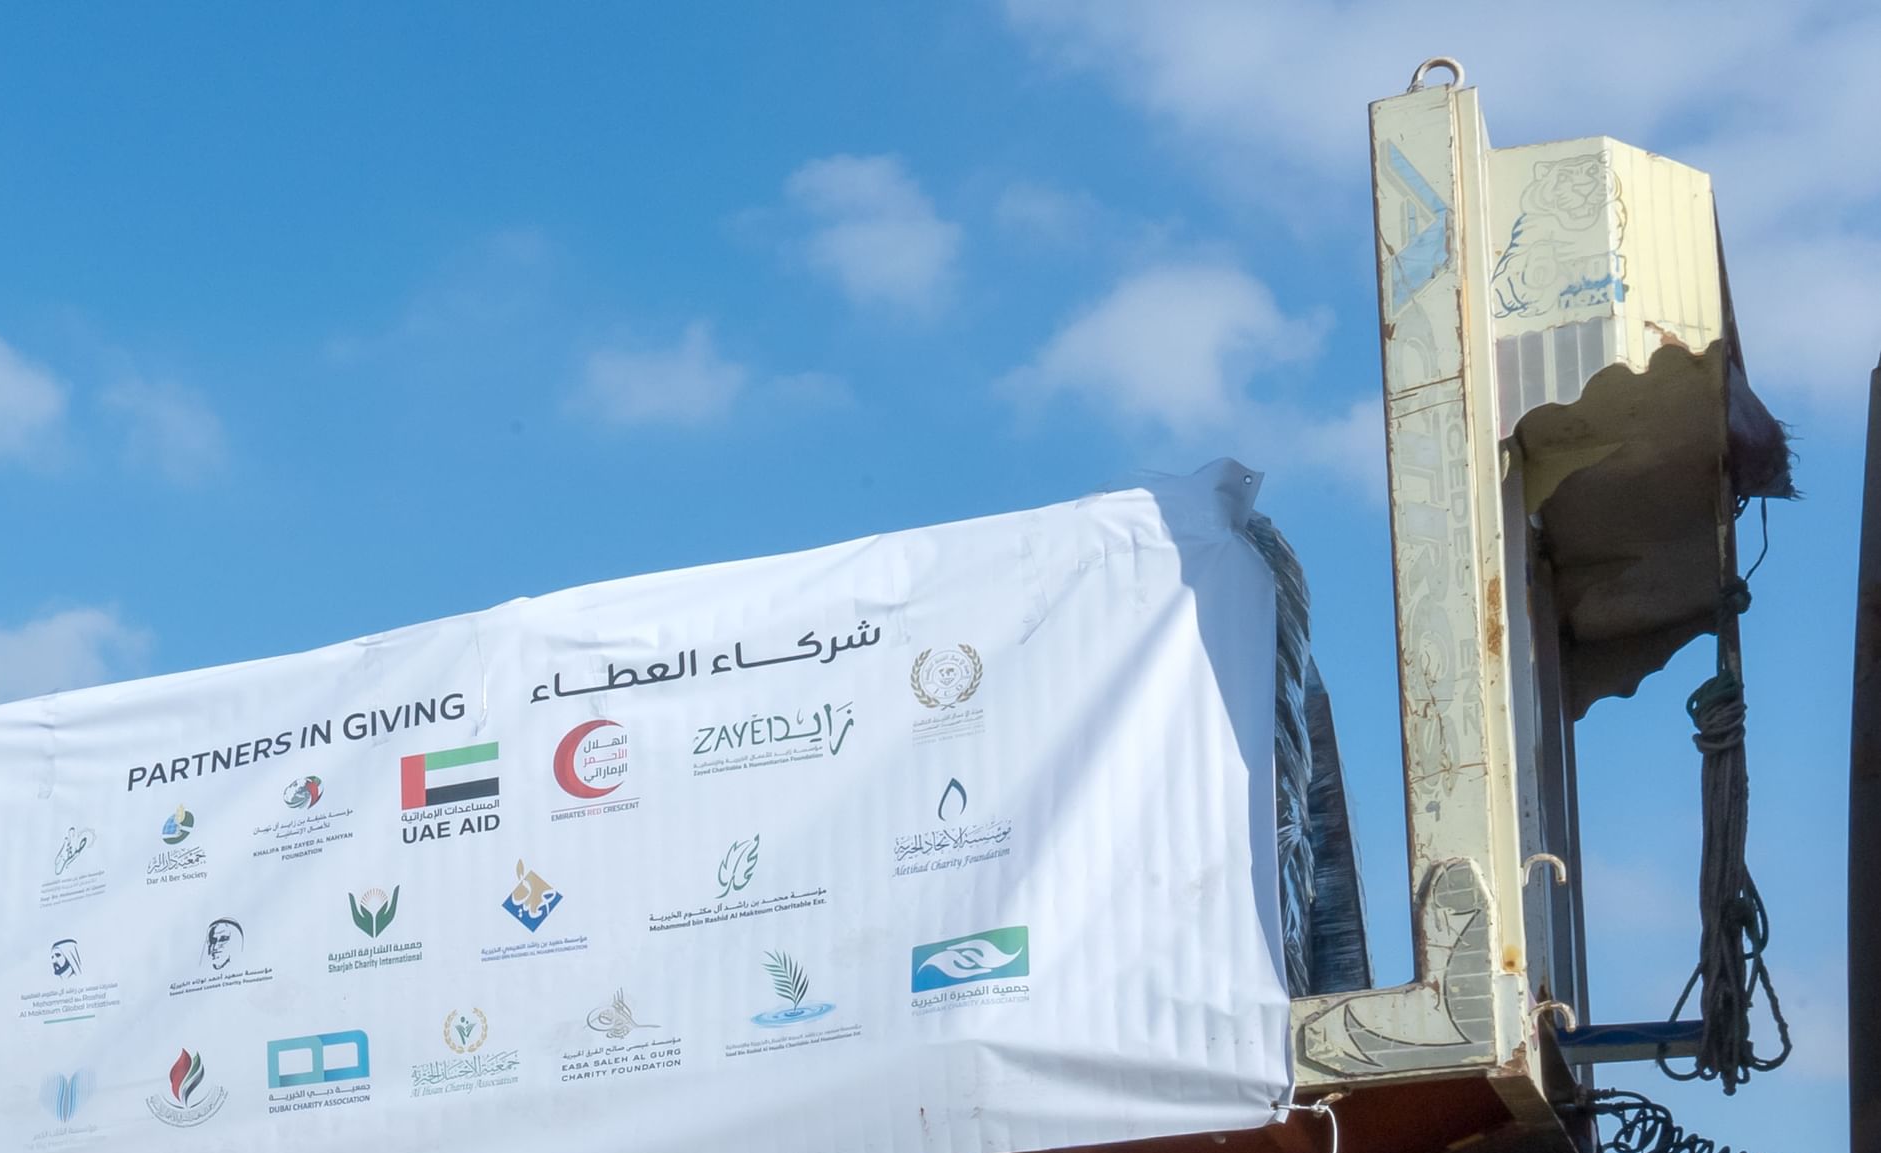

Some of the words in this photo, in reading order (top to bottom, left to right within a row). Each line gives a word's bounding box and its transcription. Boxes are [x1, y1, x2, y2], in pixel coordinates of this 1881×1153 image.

[711, 619, 881, 676] شركاء
[530, 649, 697, 704] العطاء
[127, 731, 291, 792] PARTNERS
[300, 719, 333, 750] IN
[343, 693, 466, 742] GIVING
[583, 734, 627, 754] الهلال
[401, 807, 443, 824] الإماراتية
[444, 799, 500, 816] المساعدات
[551, 809, 586, 822] EMIRATES
[587, 806, 601, 817] RED
[603, 801, 639, 814] CRESCENT
[402, 821, 451, 844] UAE
[459, 814, 500, 836] AID
[253, 847, 280, 857] KHALIFA
[281, 844, 293, 852] BIN
[294, 839, 315, 849] ZAYED
[316, 837, 324, 845] AL
[281, 847, 323, 861] FOUNDATION
[146, 876, 159, 885] Dar
[160, 875, 168, 884] Al
[169, 874, 181, 883] Ber
[182, 871, 208, 882] Society
[649, 919, 691, 932] Mohammed
[692, 917, 703, 926] bin
[705, 913, 729, 925] Rashid
[730, 911, 738, 920] Al
[739, 907, 774, 918] Maktoum
[774, 900, 811, 912] Charitable
[393, 941, 423, 953] جمعية
[328, 962, 353, 973] Sharjah
[354, 958, 378, 969] Charity
[379, 951, 423, 966] International
[950, 985, 989, 1002] الفجيرة
[992, 985, 1030, 997] جمعية
[911, 992, 947, 1009] الخيرية
[561, 1062, 589, 1072] EASA
[593, 1056, 628, 1067] SALEH
[633, 1054, 646, 1062] AL
[650, 1048, 681, 1060] GURG
[561, 1070, 607, 1082] CHARITY
[611, 1059, 681, 1075] FOUNDATION
[268, 1090, 305, 1101] الخيرية
[306, 1088, 334, 1098] دبي
[335, 1083, 371, 1094] جمعية
[269, 1103, 291, 1113] DUBAI
[292, 1100, 323, 1111] CHARITY
[324, 1095, 370, 1107] ASSOCIATION
